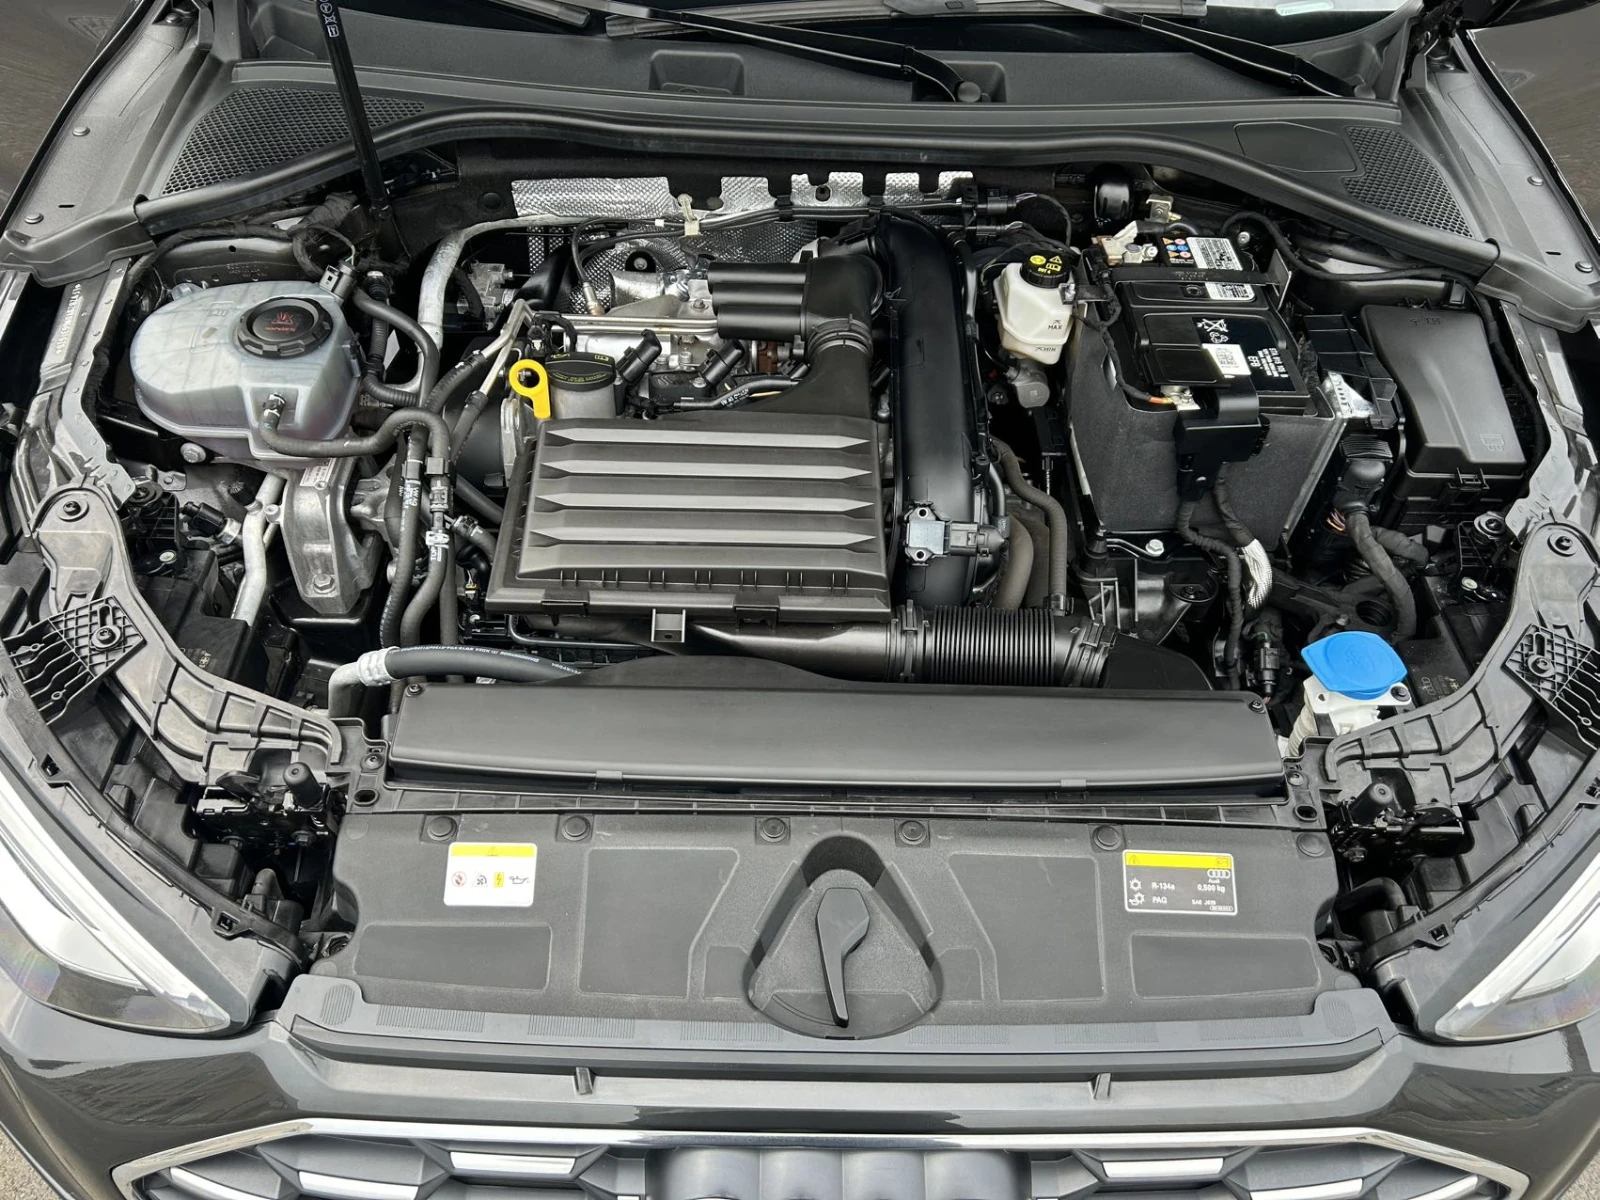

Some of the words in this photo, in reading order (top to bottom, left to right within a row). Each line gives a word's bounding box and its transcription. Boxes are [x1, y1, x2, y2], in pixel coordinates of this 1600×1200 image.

[1151, 881, 1175, 890] R-134a
[1197, 883, 1216, 892] 0,500
[1216, 885, 1225, 893] kg
[1152, 895, 1168, 904] PAG
